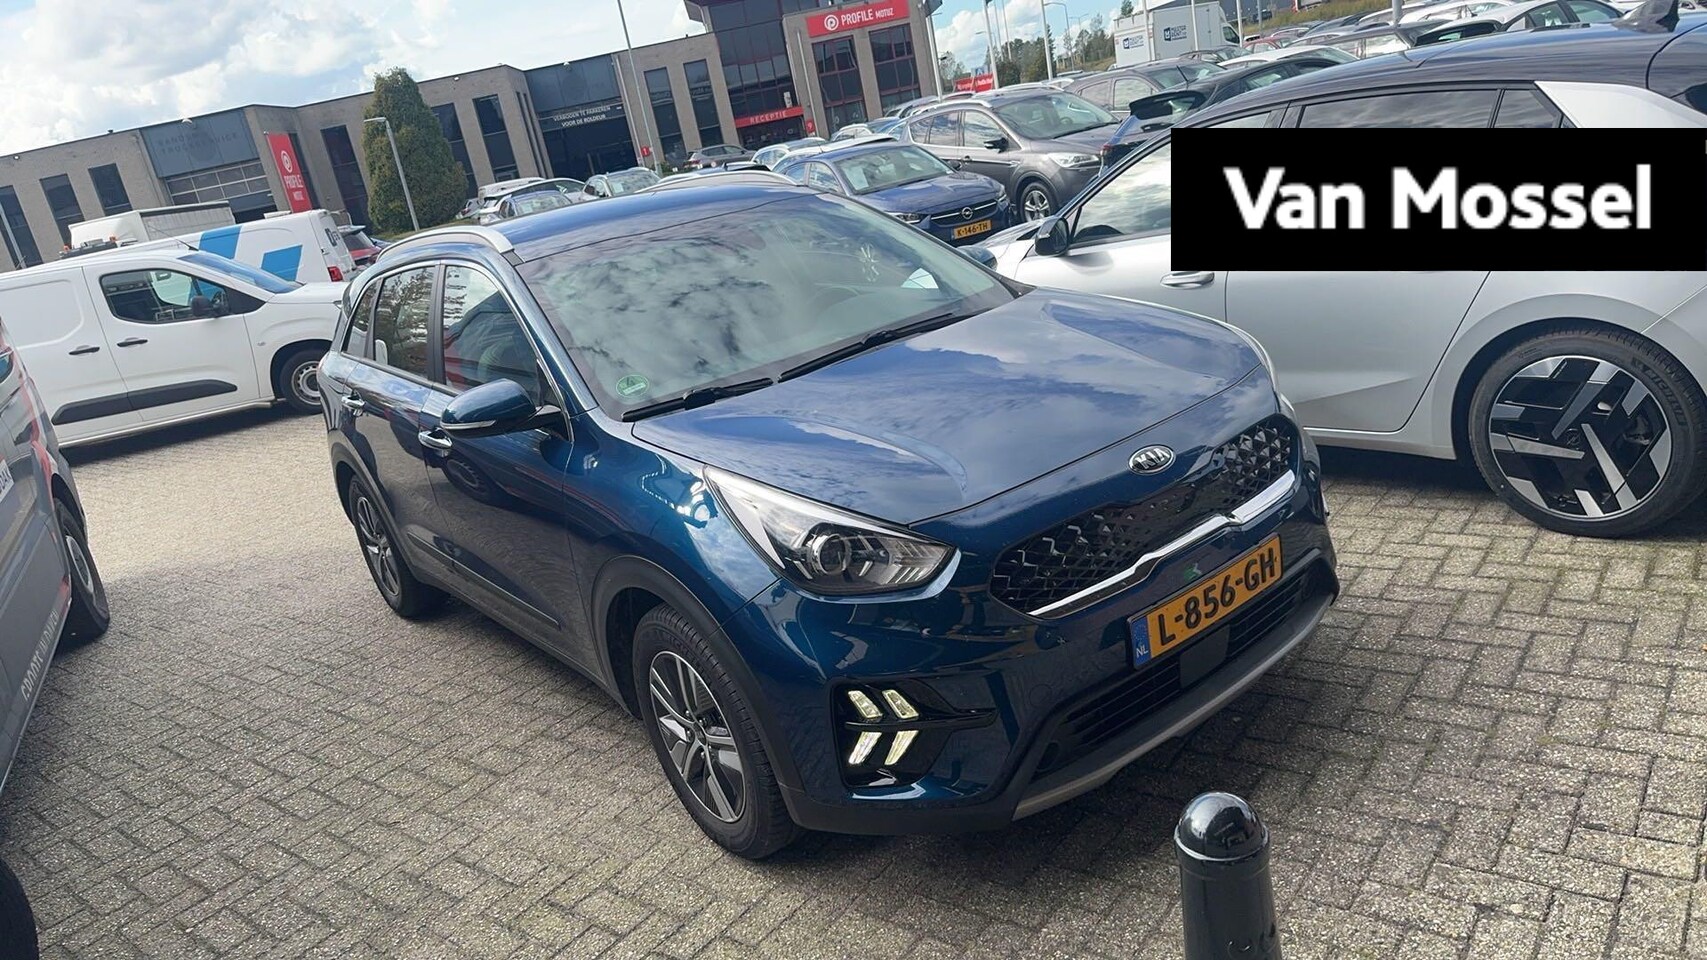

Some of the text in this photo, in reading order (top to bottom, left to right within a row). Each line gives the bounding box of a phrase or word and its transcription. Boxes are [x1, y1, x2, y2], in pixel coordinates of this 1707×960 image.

[840, 9, 873, 26] PROFILE
[875, 8, 894, 19] MOTUZ
[584, 114, 606, 123] ROLDEUR
[750, 110, 787, 124] RECEPTIE
[957, 222, 988, 237] K-146-TH
[1135, 448, 1170, 469] KIA
[1158, 547, 1275, 646] L-856-GH
[1136, 644, 1149, 657] NL
